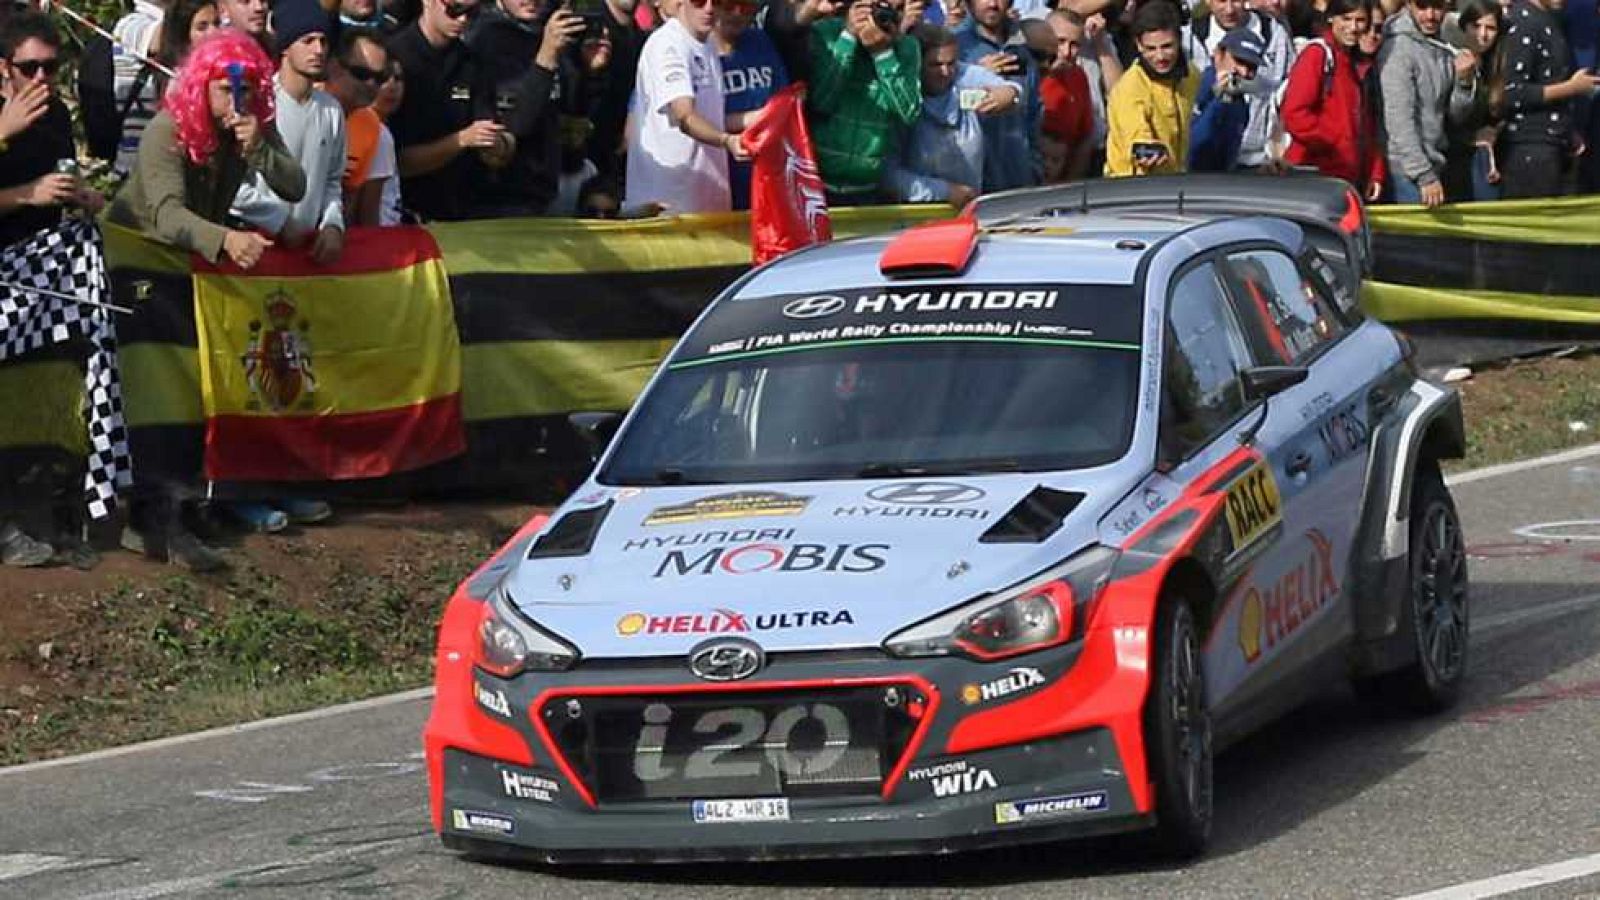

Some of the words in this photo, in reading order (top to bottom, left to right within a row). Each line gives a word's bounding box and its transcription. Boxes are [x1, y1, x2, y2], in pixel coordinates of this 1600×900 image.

[854, 290, 1058, 313] HYUNDAI
[756, 333, 784, 347] FIA
[789, 327, 838, 342] World
[841, 324, 885, 337] Rally
[889, 321, 1012, 335] Championship
[833, 505, 990, 520] HYUNDAI
[1227, 469, 1276, 538] RACC
[623, 528, 796, 551] HYUNDAI
[653, 543, 890, 577] MOBIS
[1264, 527, 1339, 647] HELIX
[645, 608, 752, 633] HELIX
[755, 610, 854, 630] ULTRA
[981, 667, 1046, 700] HELIX
[634, 703, 849, 781] i20
[908, 760, 967, 781] HYUNDAI
[1024, 796, 1102, 814] MICHELIN
